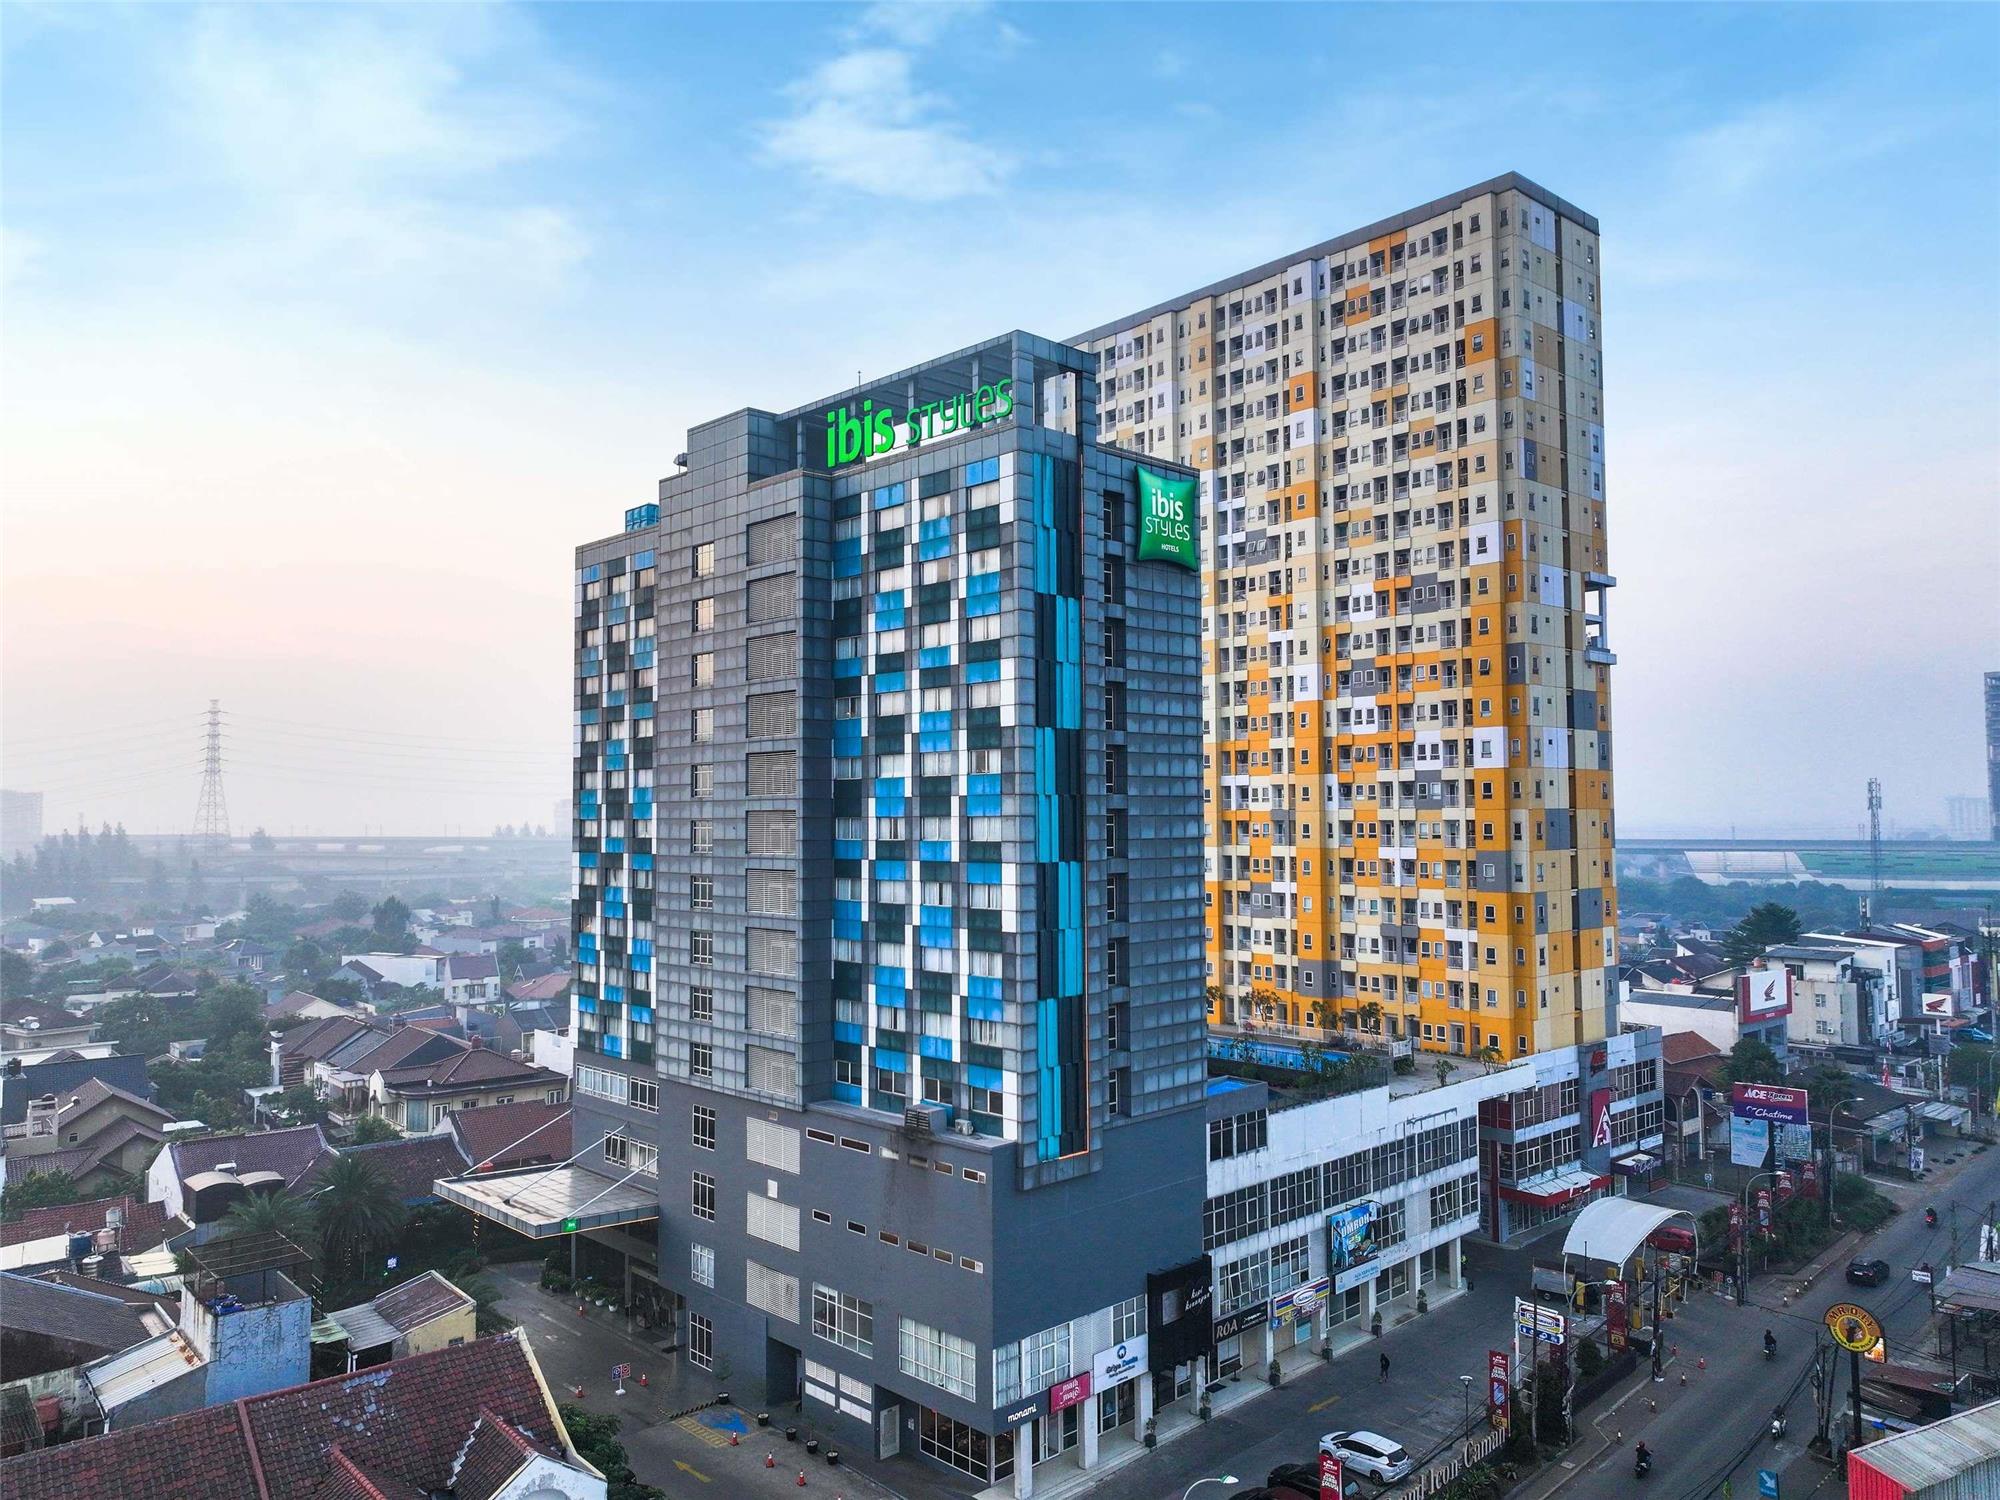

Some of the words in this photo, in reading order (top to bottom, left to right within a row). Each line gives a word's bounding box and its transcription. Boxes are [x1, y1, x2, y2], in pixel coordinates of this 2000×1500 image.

[827, 400, 895, 468] ibis
[1151, 487, 1184, 521] ibis
[1161, 543, 1180, 553] HOTELS
[1744, 1088, 1767, 1100] ACE
[1755, 1108, 1793, 1120] Chatime
[1341, 1212, 1370, 1237] UMROH
[1216, 1318, 1238, 1339] ROA
[1008, 1403, 1037, 1423] monami
[1429, 1459, 1458, 1494] Icon
[1464, 1426, 1506, 1468] Caman
